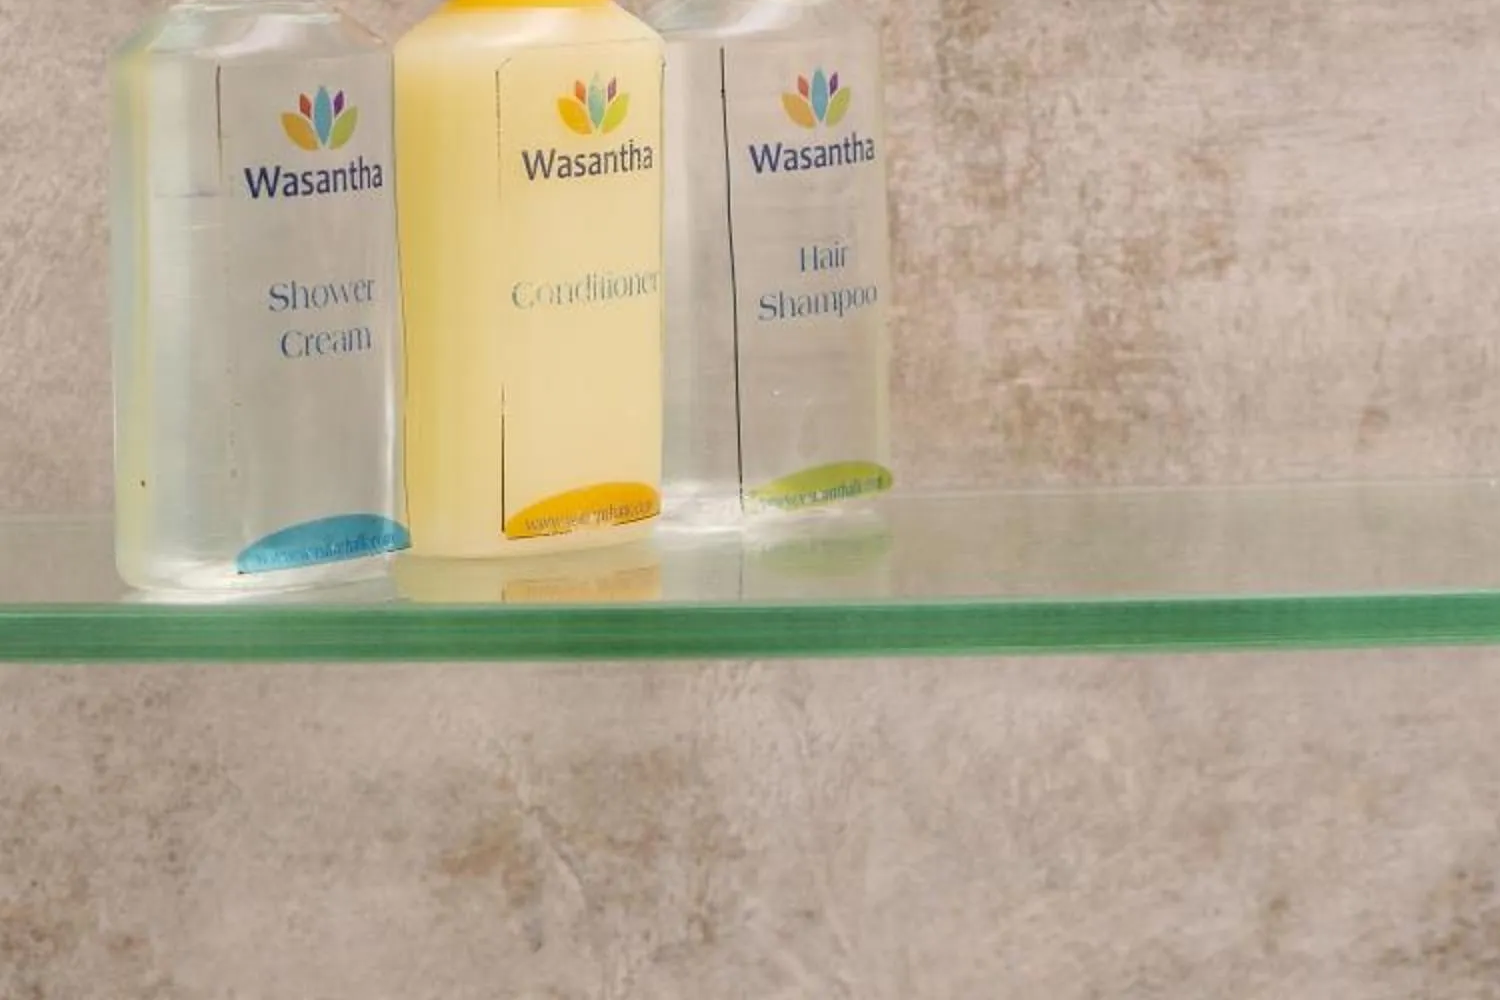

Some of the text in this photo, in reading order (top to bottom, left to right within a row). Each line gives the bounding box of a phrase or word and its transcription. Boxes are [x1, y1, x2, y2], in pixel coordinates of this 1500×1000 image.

[521, 138, 654, 181] Wasantha
[749, 132, 875, 174] Wasantha
[244, 156, 383, 199] Wasantha
[799, 241, 850, 272] Hair
[268, 277, 375, 312] Shower
[511, 269, 661, 310] Conditioner
[758, 284, 878, 321] Shampoo
[280, 327, 372, 358] Cream
